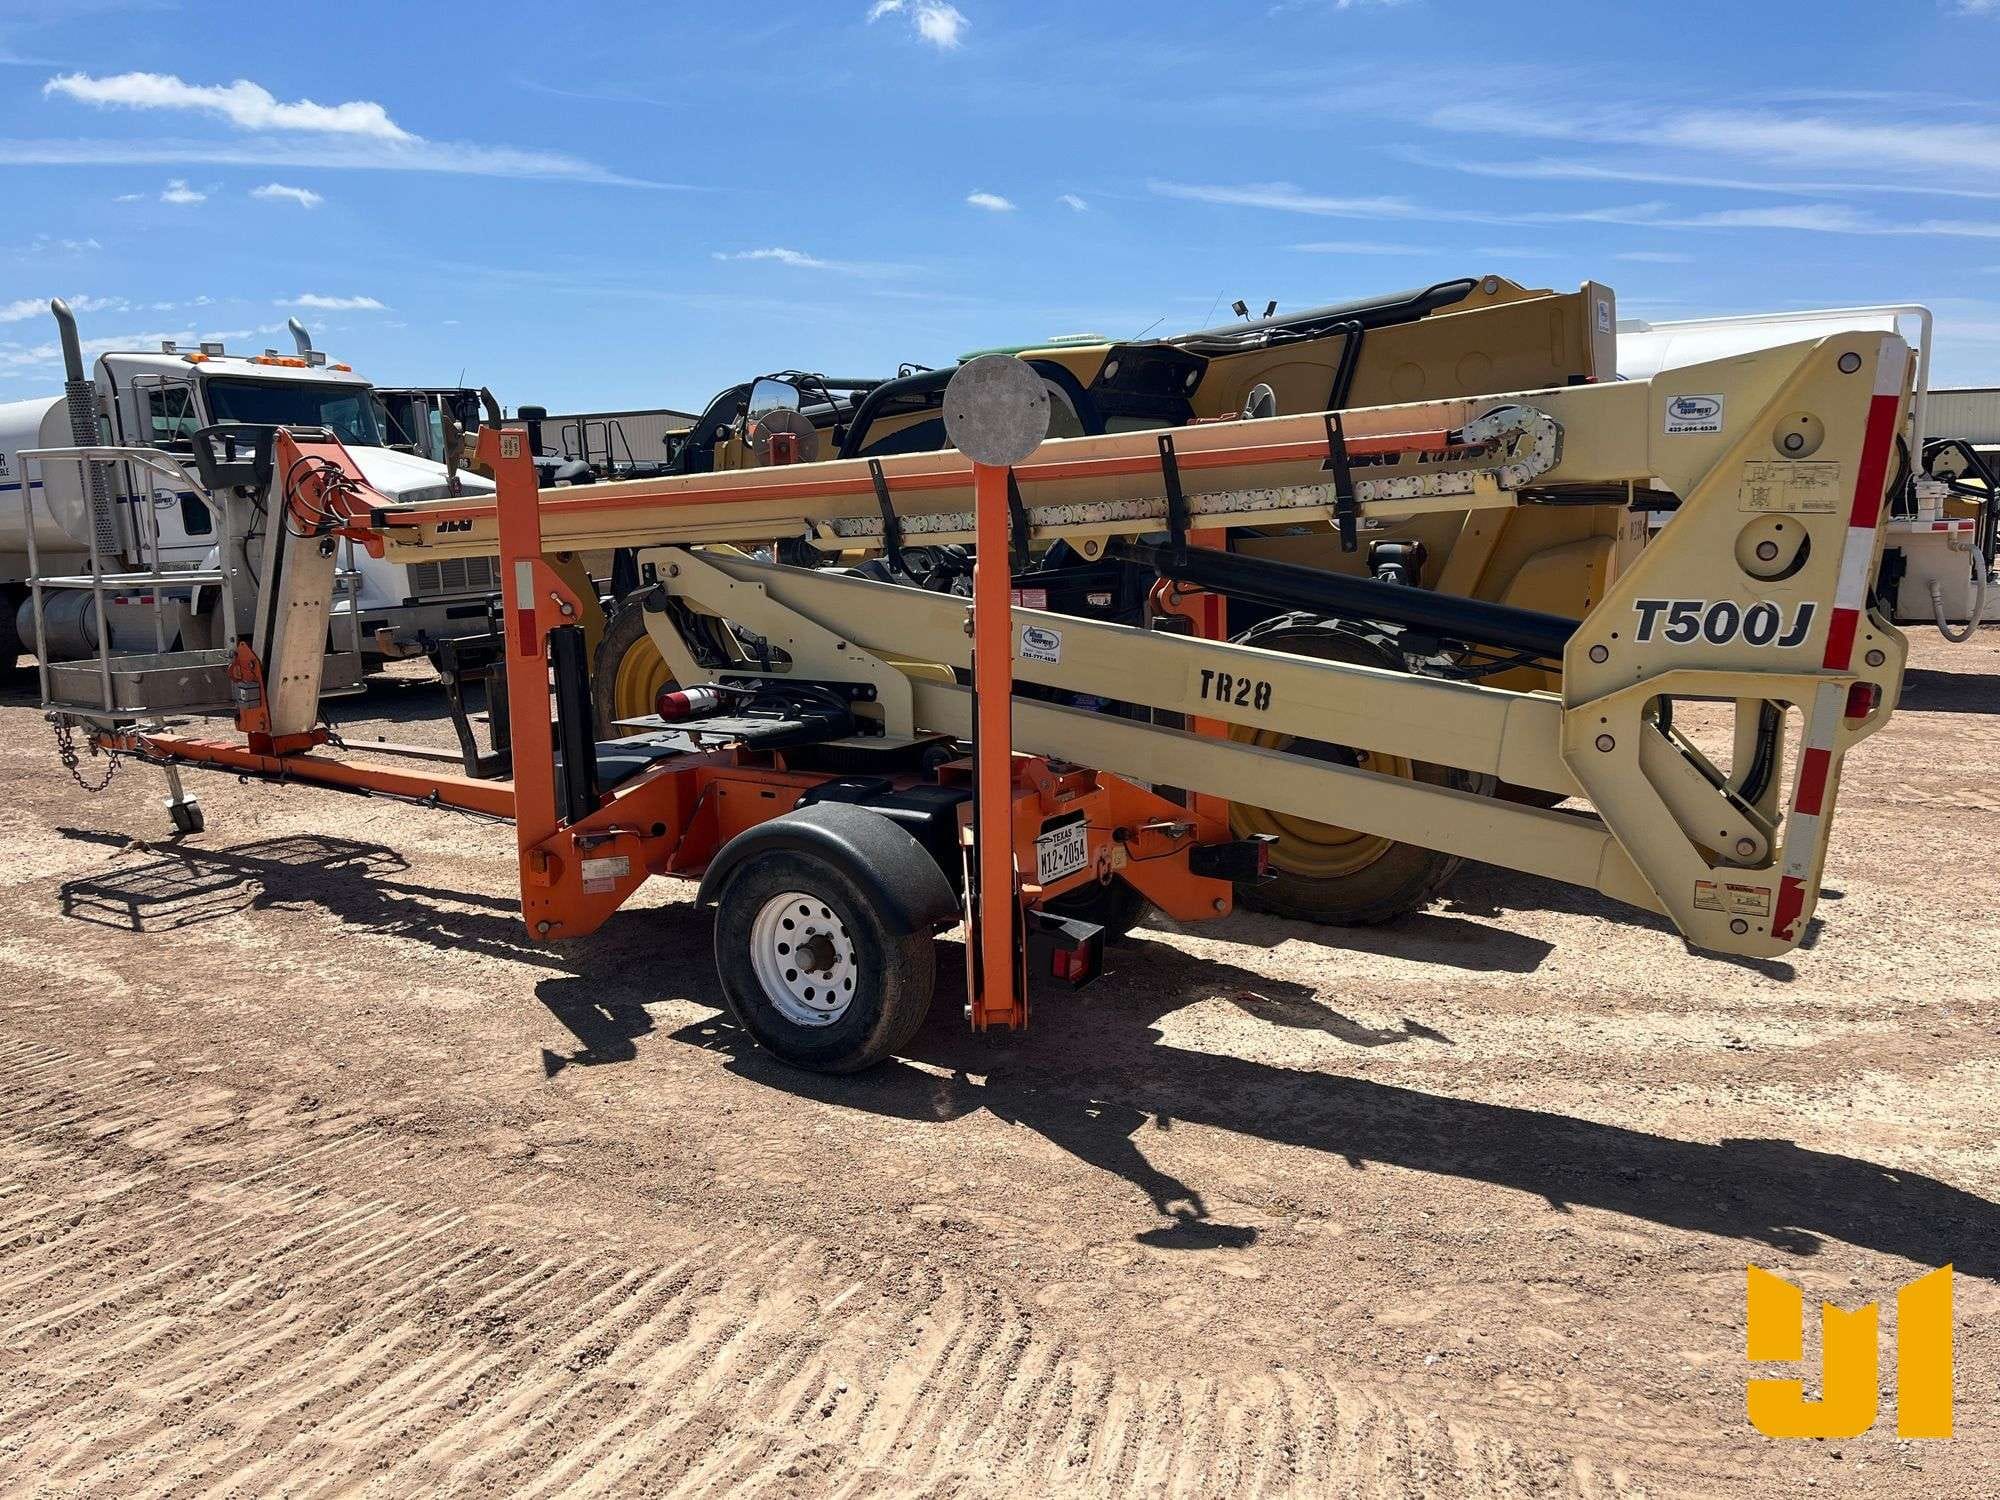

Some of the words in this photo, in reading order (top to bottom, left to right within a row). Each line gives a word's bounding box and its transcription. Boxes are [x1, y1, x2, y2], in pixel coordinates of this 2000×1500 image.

[1632, 598, 1818, 649] T500J
[1200, 669, 1272, 711] TR28
[1052, 829, 1073, 843] TEXAS
